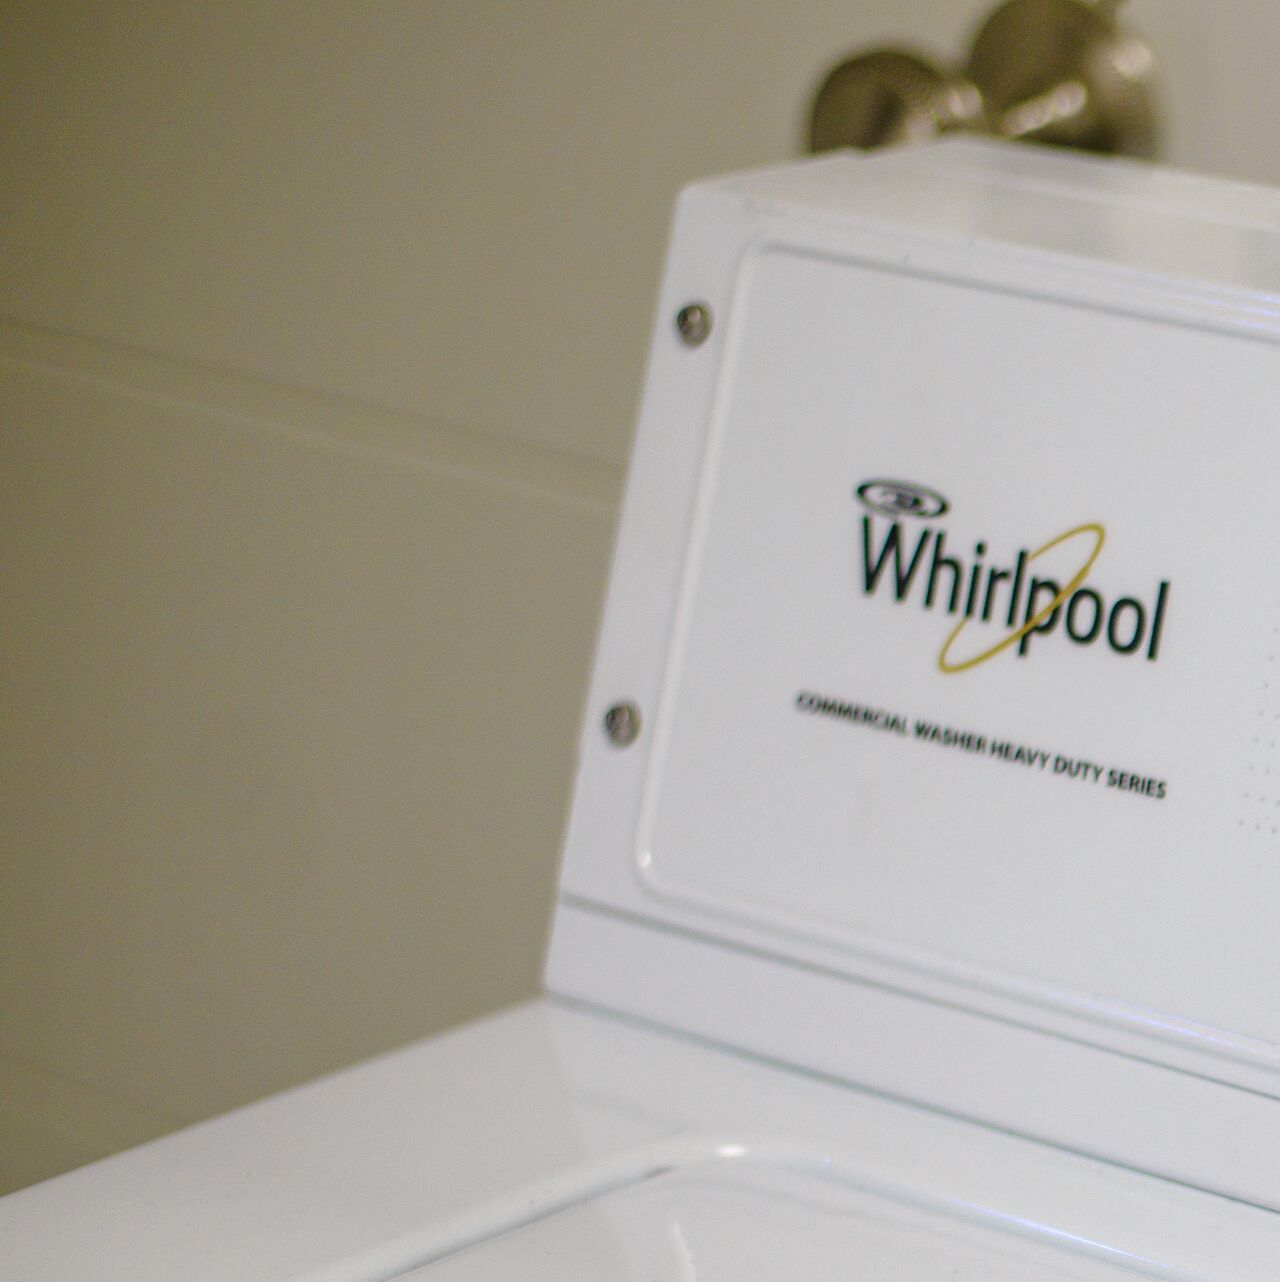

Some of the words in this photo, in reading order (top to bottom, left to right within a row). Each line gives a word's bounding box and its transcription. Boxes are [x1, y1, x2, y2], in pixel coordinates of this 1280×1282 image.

[861, 515, 1170, 661] Whirlpool
[796, 691, 907, 736] COMMERCIAL
[912, 719, 987, 754] WASHER
[989, 739, 1050, 770] HEAVY
[1053, 754, 1104, 784] DUTY
[1106, 768, 1167, 800] SERIES
